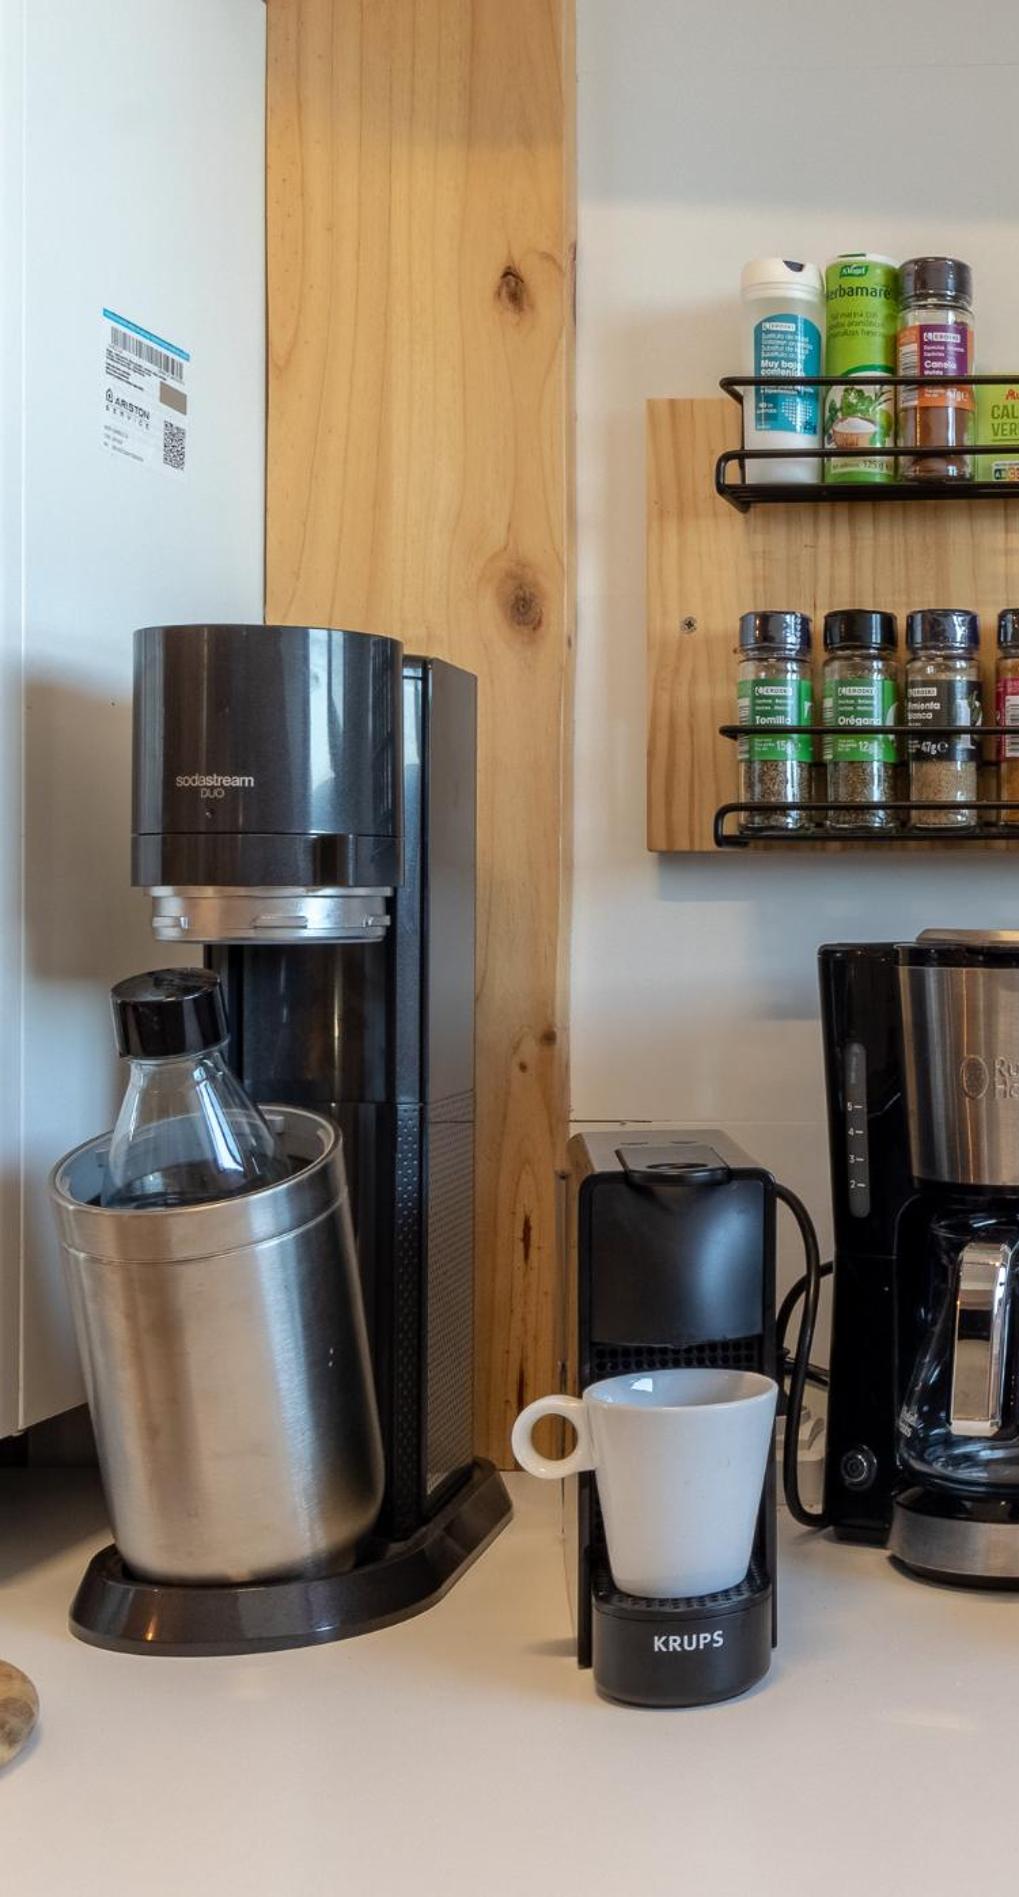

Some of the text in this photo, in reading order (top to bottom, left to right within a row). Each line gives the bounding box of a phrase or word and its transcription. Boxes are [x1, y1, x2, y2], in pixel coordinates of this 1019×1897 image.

[761, 360, 779, 369] Muy
[114, 397, 150, 421] ARISTON
[755, 715, 791, 725] Tomillo
[838, 714, 881, 726] Orégano
[176, 773, 256, 788] sodastream
[200, 787, 225, 799] DUO
[653, 1630, 725, 1652] KRUPS
